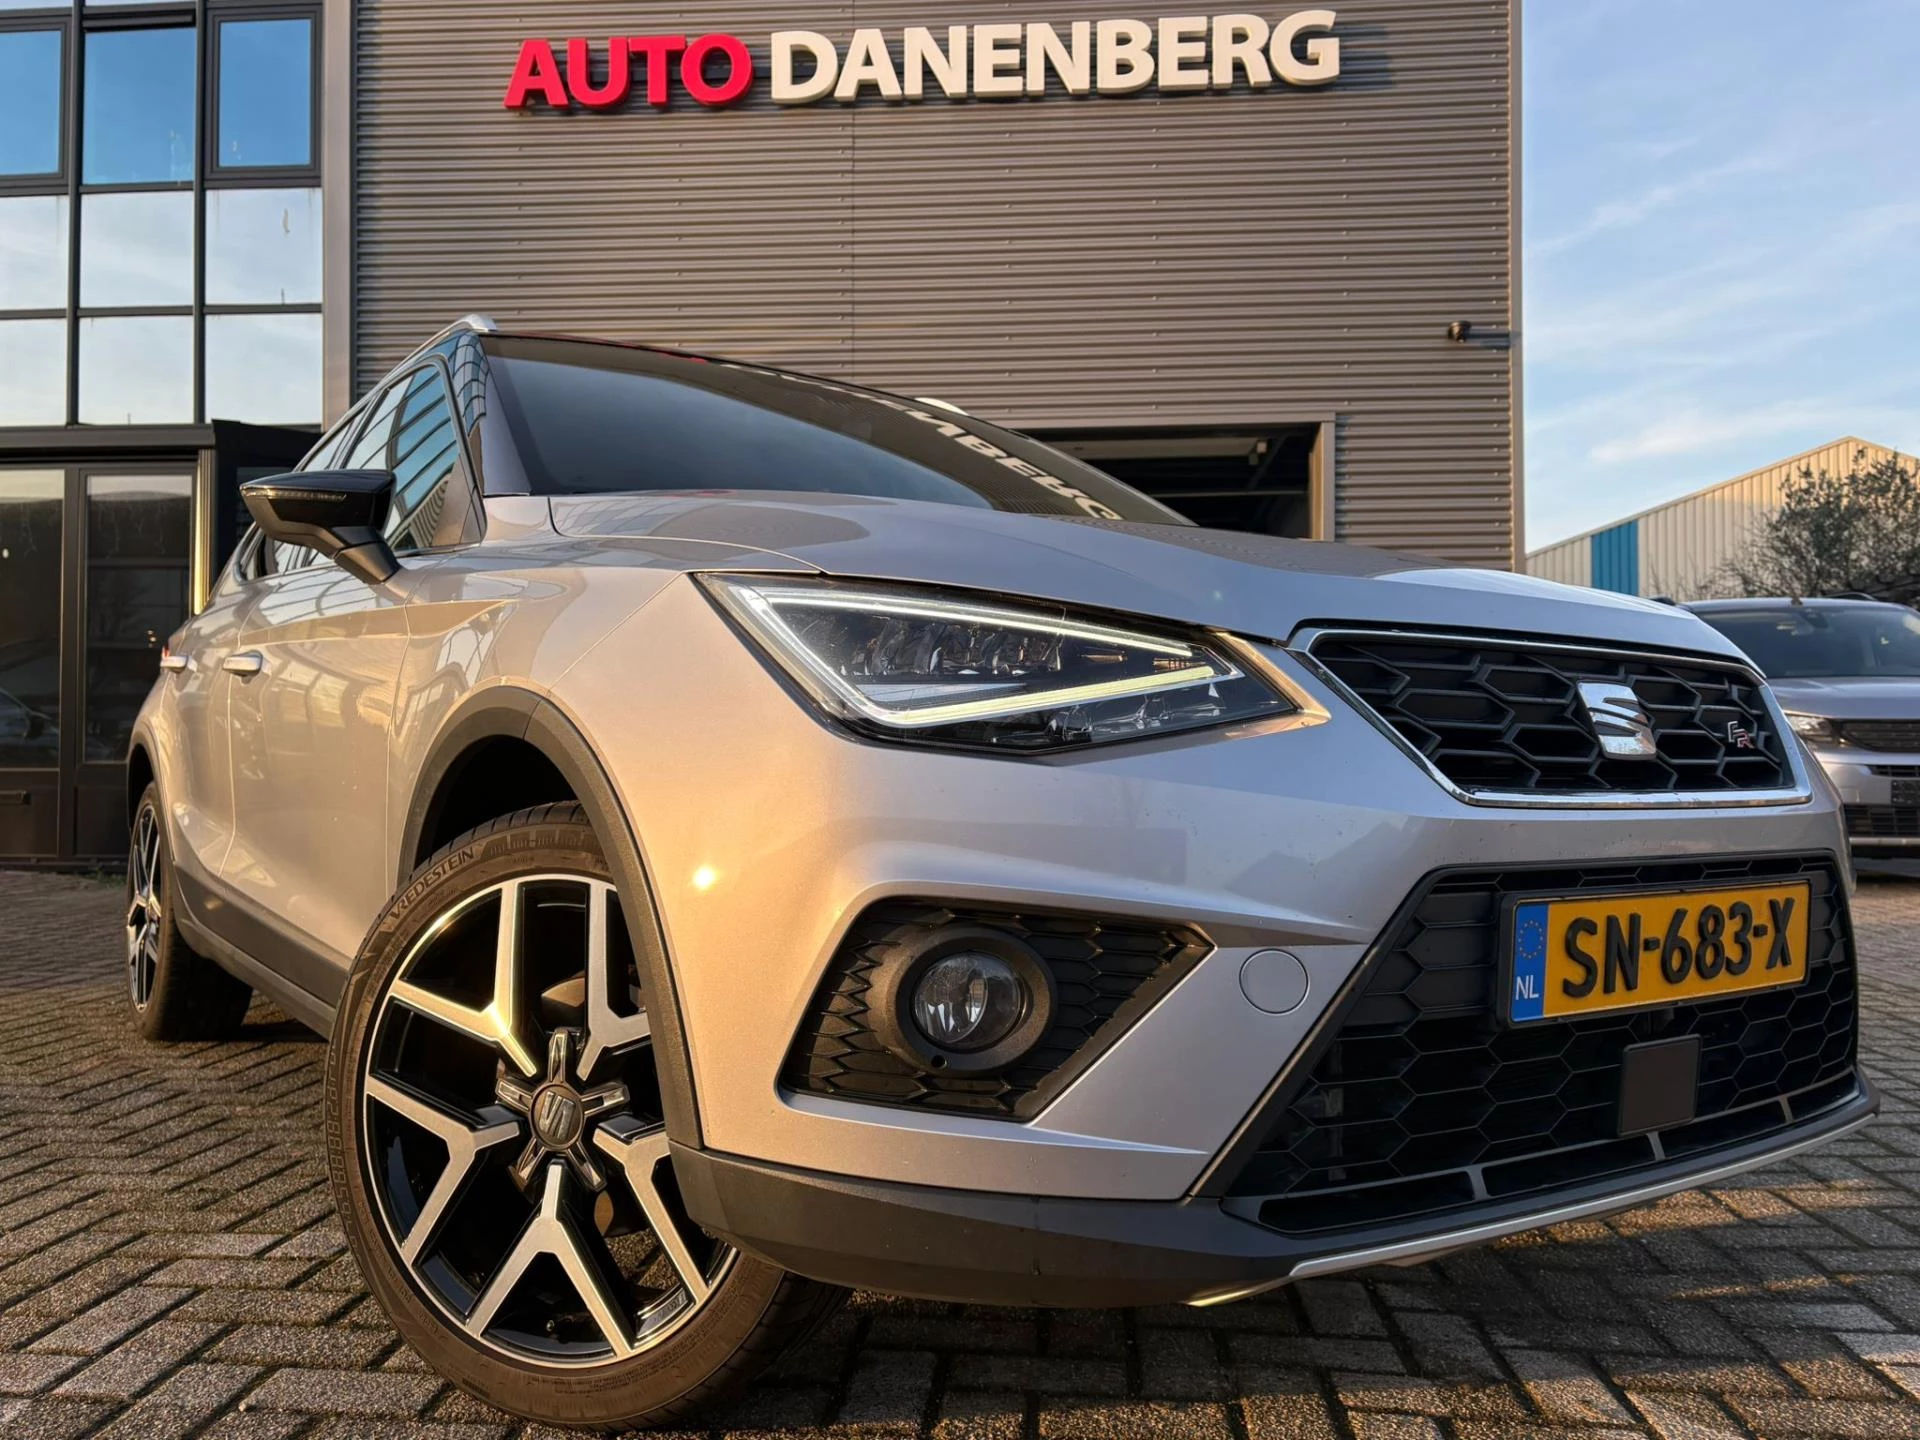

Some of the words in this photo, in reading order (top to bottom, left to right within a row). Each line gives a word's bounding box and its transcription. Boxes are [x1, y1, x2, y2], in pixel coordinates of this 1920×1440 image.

[503, 32, 754, 109] AUTO
[769, 9, 1341, 105] DANENBERG
[388, 846, 475, 920] VREDESTEIN
[1515, 974, 1540, 1001] NL
[1562, 897, 1795, 999] SN-683-X
